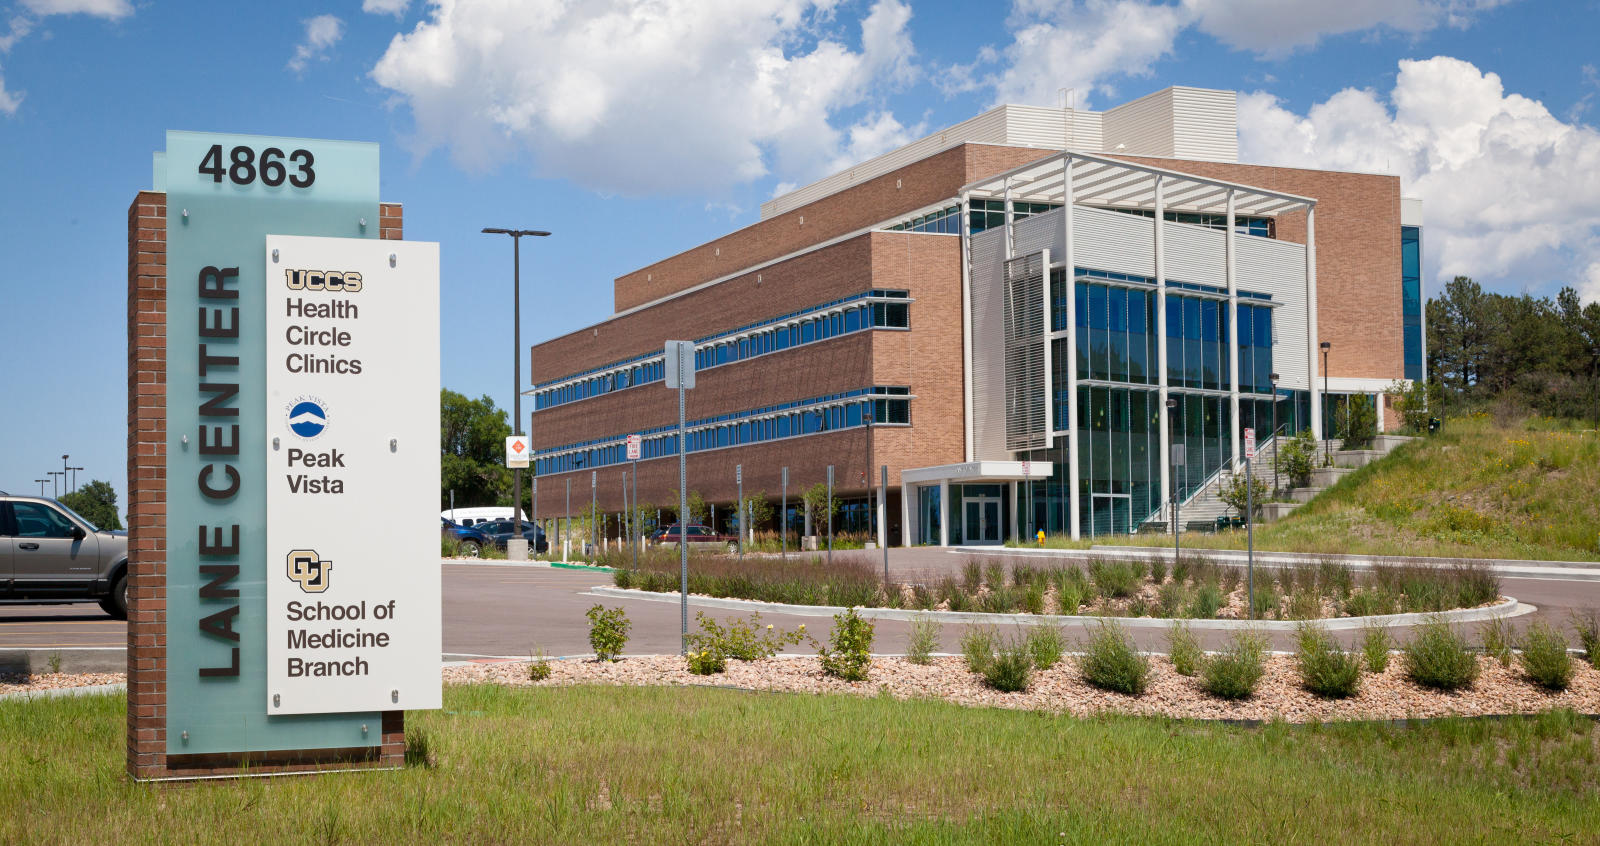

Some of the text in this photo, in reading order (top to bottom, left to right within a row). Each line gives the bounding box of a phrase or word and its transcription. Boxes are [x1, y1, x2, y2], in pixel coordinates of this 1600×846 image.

[198, 144, 316, 189] 4863
[285, 269, 363, 292] UCCS
[286, 298, 358, 319] Health
[286, 326, 352, 347] Circle
[286, 353, 362, 375] Clinics
[287, 448, 346, 468] Peak
[198, 265, 241, 677] LANE CENTER
[286, 474, 344, 494] Vista
[287, 549, 333, 593] CU
[286, 600, 396, 622] School of
[287, 628, 390, 650] Medicine
[287, 656, 369, 678] Branch
